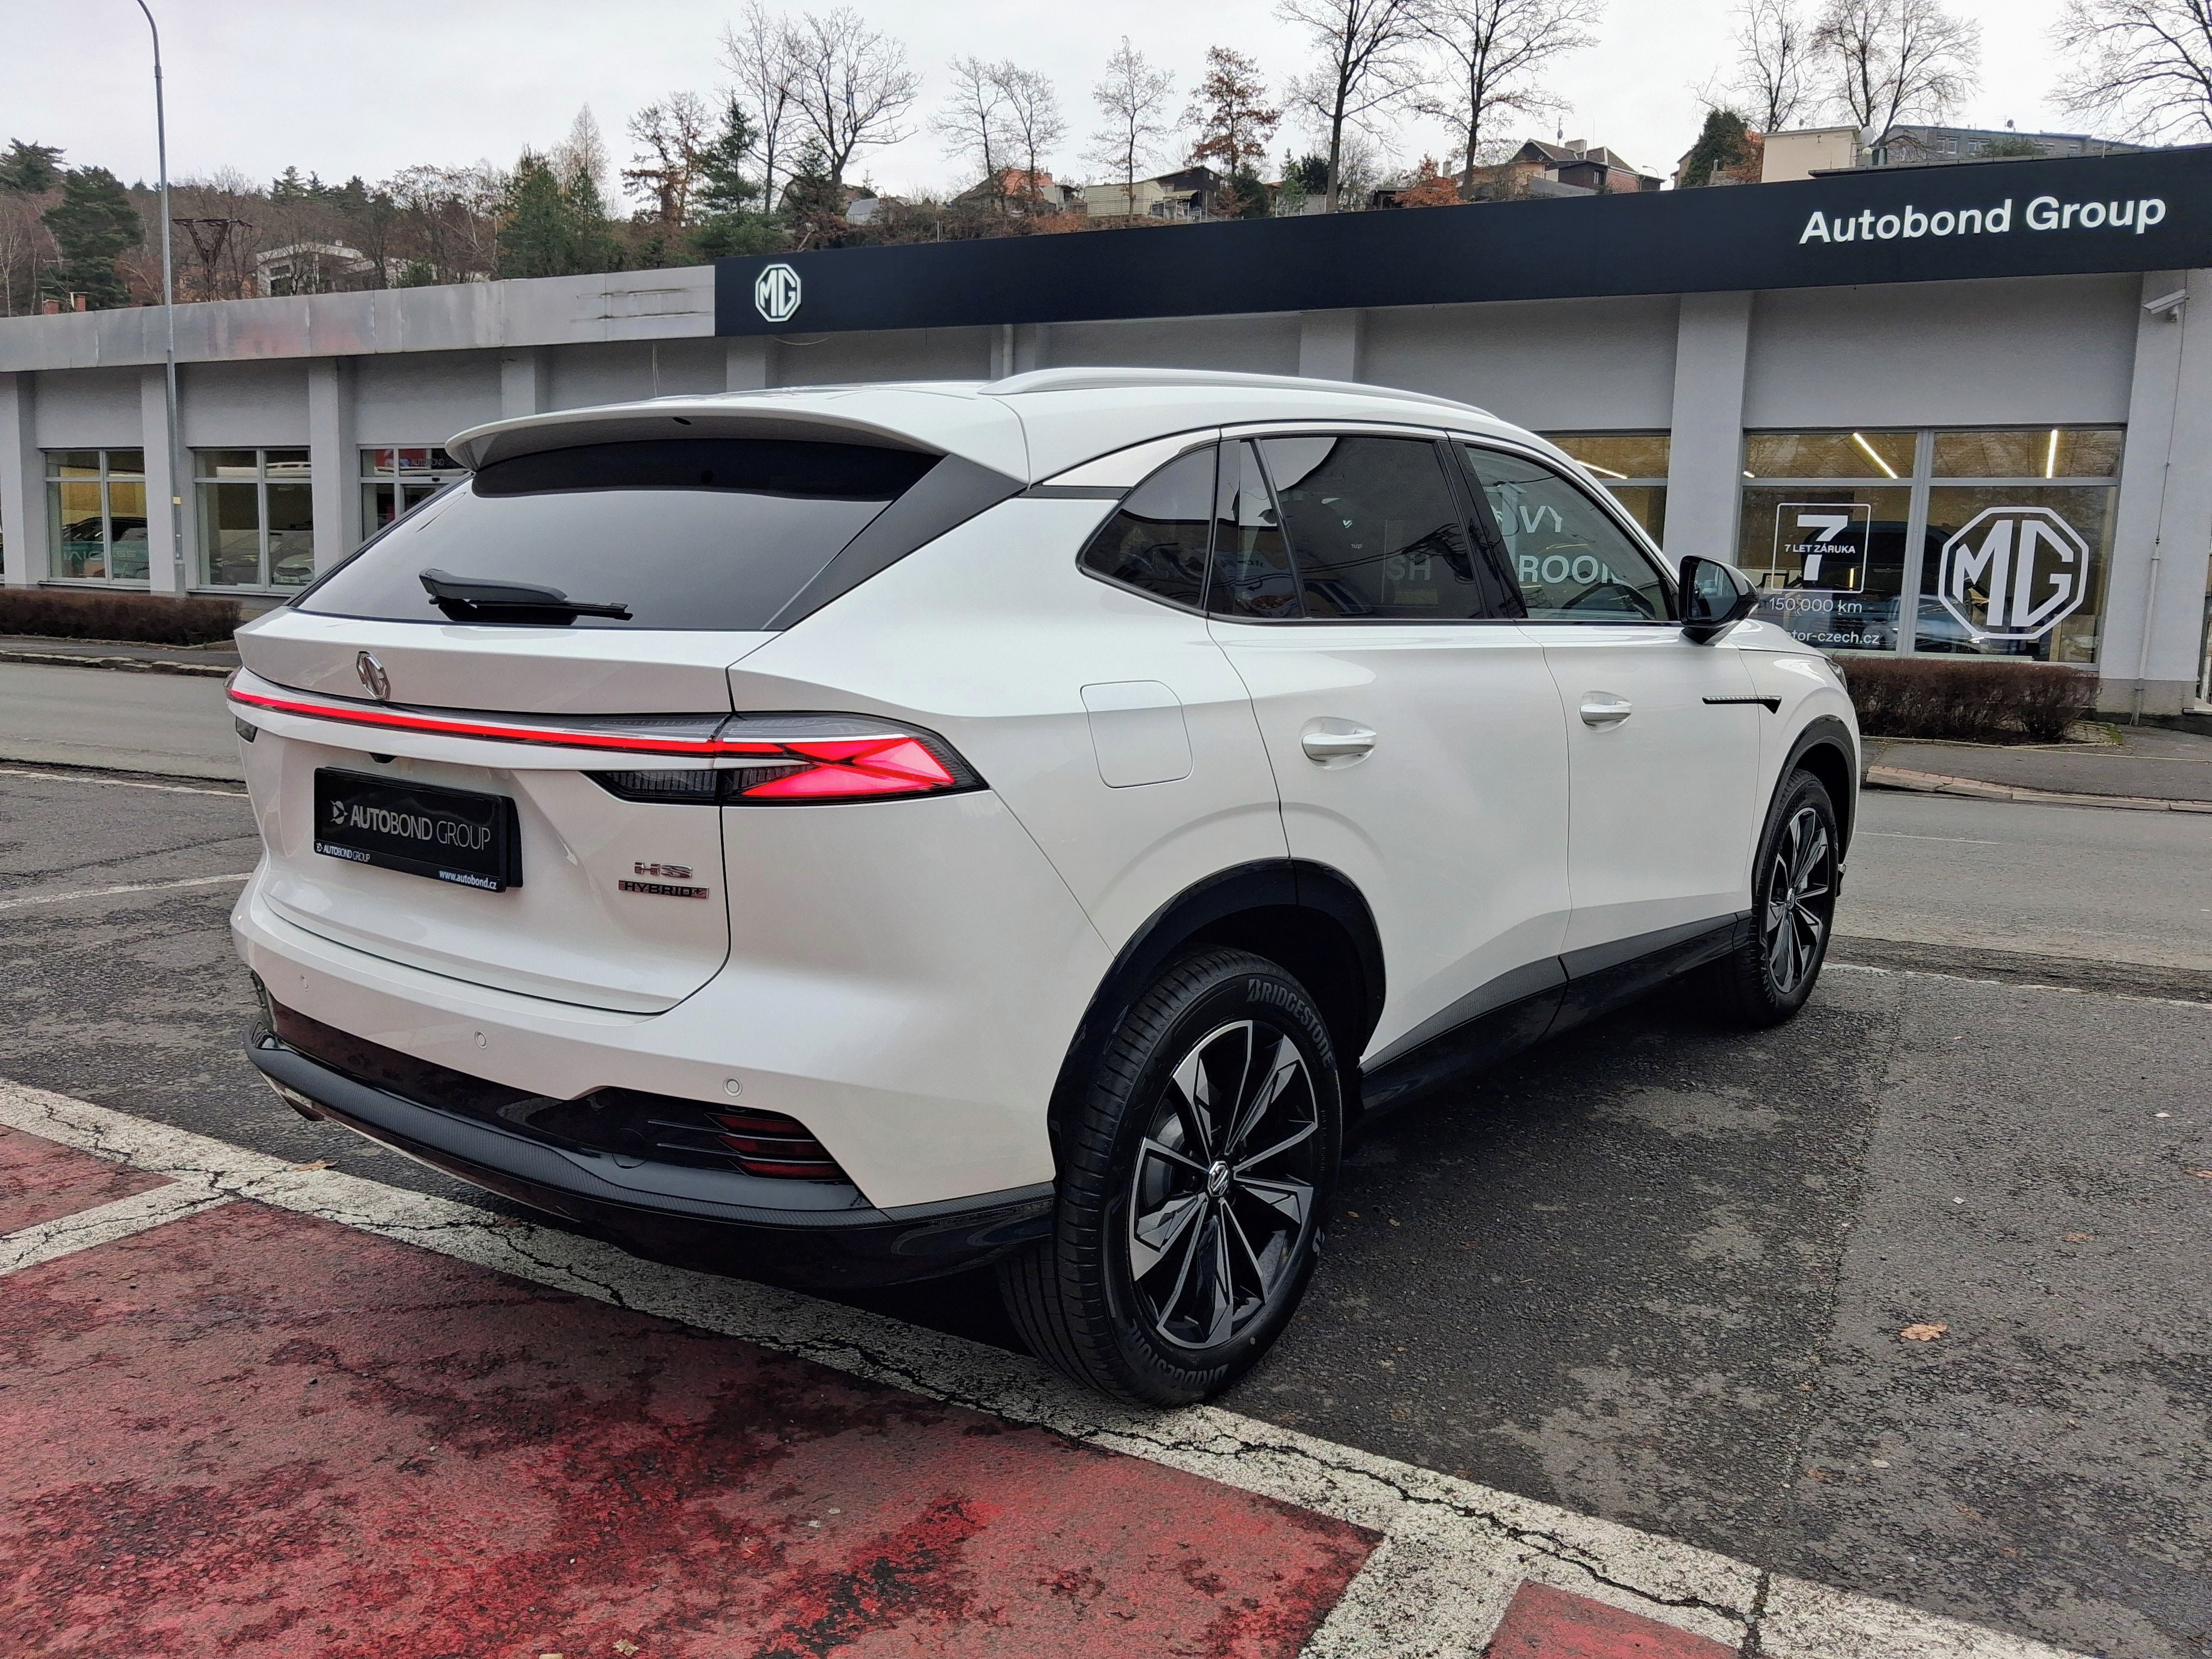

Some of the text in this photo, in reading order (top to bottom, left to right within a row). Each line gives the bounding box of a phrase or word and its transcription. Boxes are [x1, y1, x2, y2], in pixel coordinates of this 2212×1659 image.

[1799, 196, 2166, 244] Autobond Group
[760, 269, 796, 316] MG
[1784, 543, 1856, 554] 7 LET ZÁRUKA
[1952, 519, 2074, 627] MG
[1838, 599, 1862, 613] km
[1788, 629, 1880, 645] tor-czech.cz
[350, 804, 491, 851] AUTOBOND GROUP
[323, 844, 370, 863] AUTOBOND GROUP
[634, 861, 693, 878] HS
[439, 870, 497, 890] www.autobond.cz
[1246, 978, 1333, 1068] BRIDGESTONE
